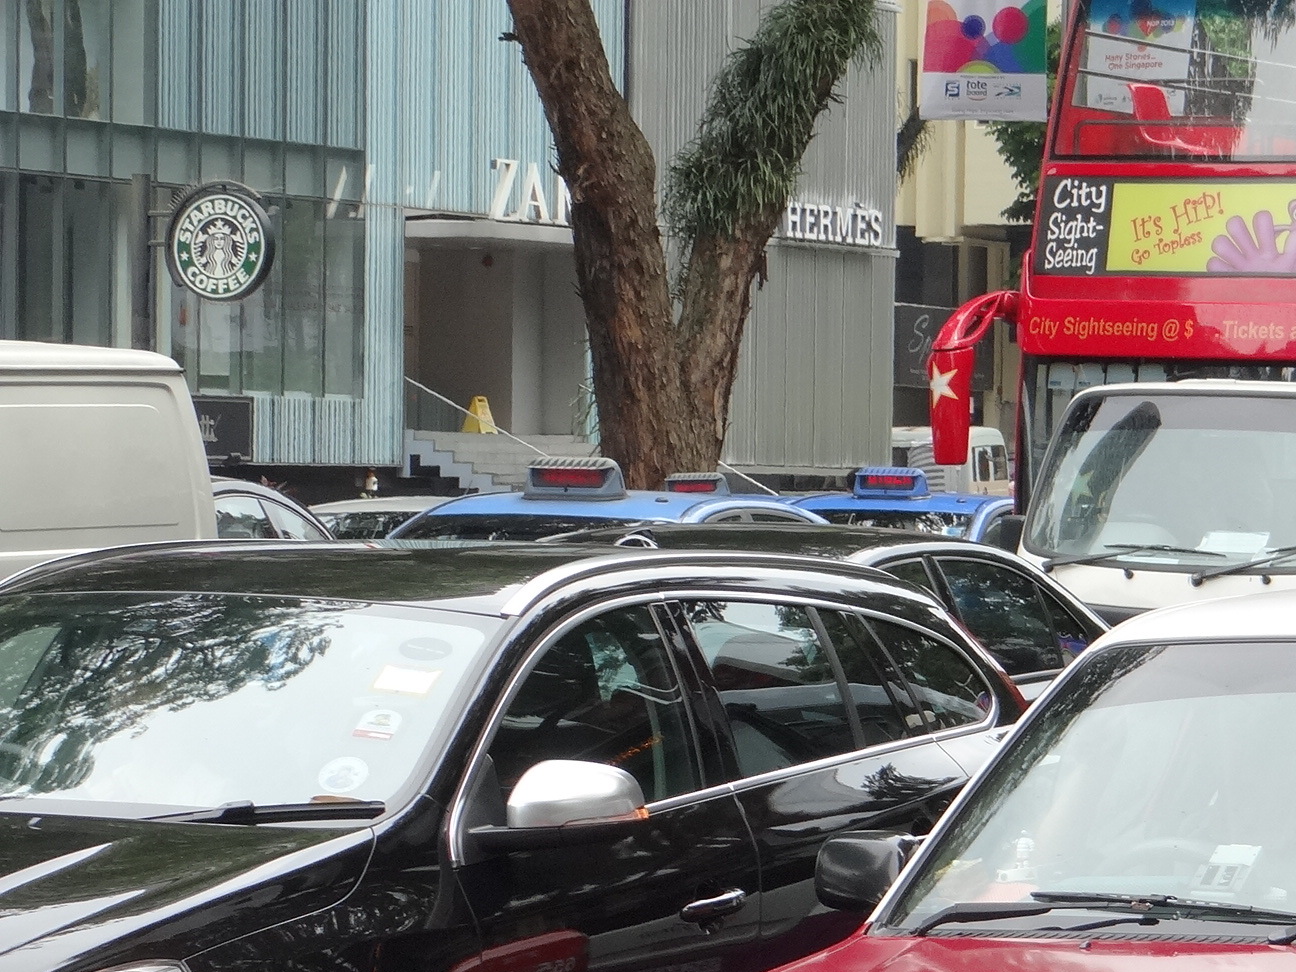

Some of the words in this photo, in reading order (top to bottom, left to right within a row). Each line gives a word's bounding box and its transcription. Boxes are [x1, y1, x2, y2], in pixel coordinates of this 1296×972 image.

[1053, 178, 1107, 213] City
[179, 199, 260, 244] STARBUCKS
[1047, 212, 1104, 248] Sight-
[1131, 216, 1164, 243] It's
[1044, 242, 1098, 275] Seeing
[1130, 248, 1151, 266] Go
[186, 266, 250, 294] COFFEE
[1029, 317, 1060, 340] City
[1063, 316, 1158, 342] Sightseeing
[1161, 318, 1181, 342] @
[1184, 319, 1195, 340] $
[1222, 320, 1285, 340] Tickets
